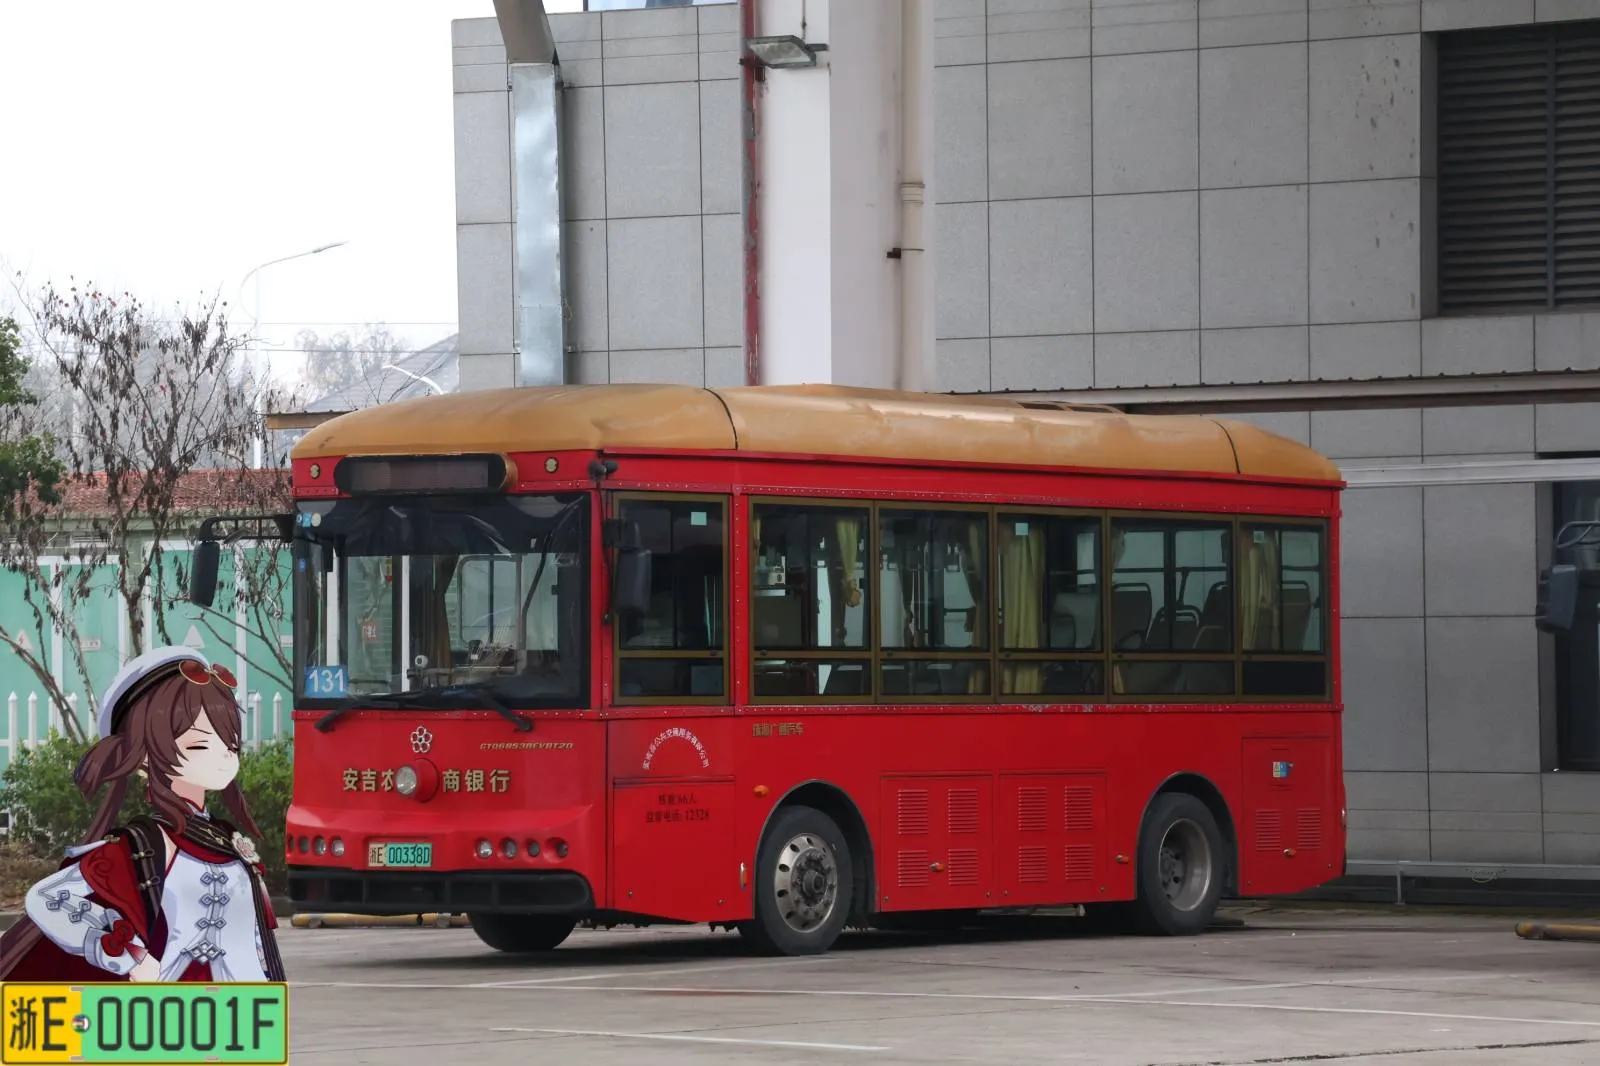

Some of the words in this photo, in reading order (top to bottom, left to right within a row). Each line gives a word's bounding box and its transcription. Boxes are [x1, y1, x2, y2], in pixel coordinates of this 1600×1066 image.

[308, 668, 344, 692] 131
[342, 767, 510, 793] 安吉农商银行
